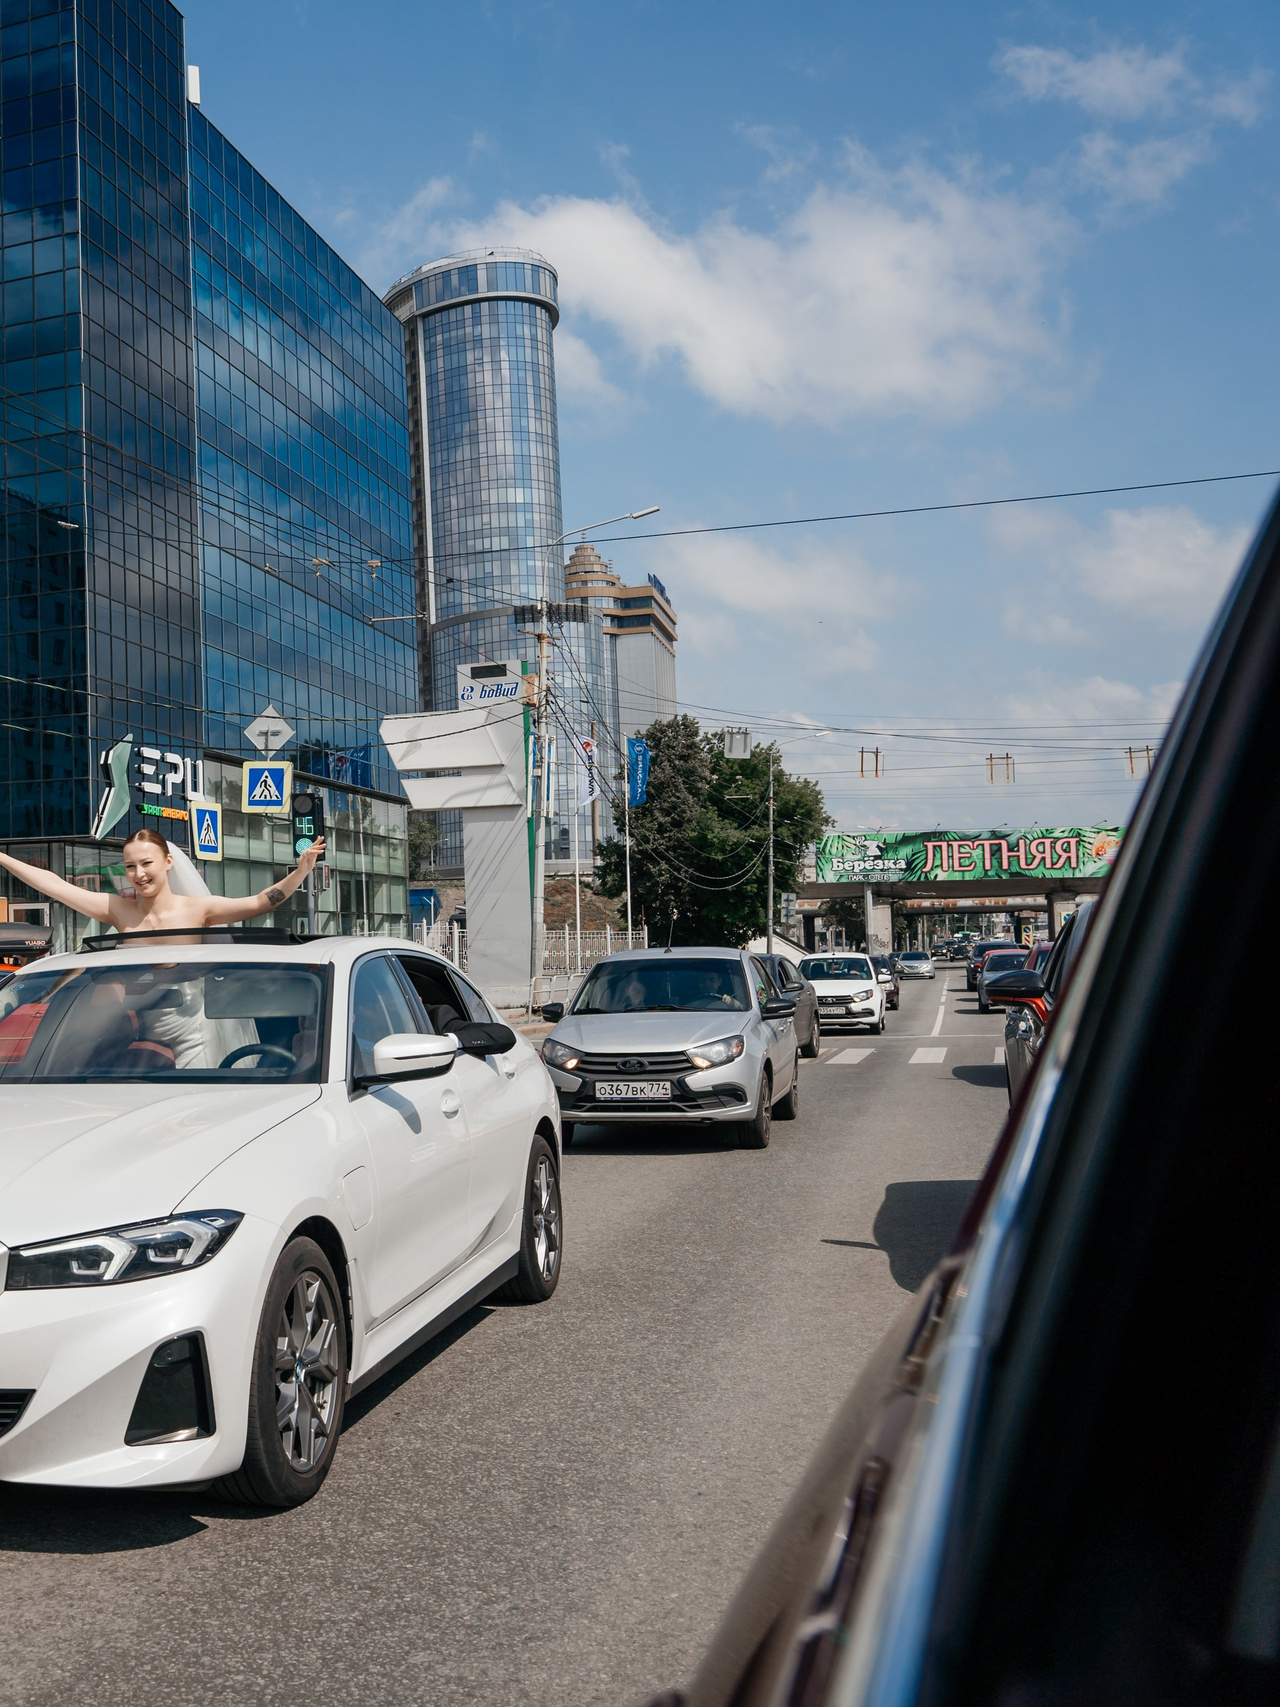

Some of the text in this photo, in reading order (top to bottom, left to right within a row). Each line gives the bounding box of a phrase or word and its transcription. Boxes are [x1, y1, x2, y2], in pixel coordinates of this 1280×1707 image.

[140, 803, 188, 821] УРАЛЭНЕРГО
[296, 817, 314, 835] 46
[922, 837, 1080, 873] ЛЕТНЯЯ
[831, 857, 907, 873] Берёзка
[649, 1083, 668, 1093] 774
